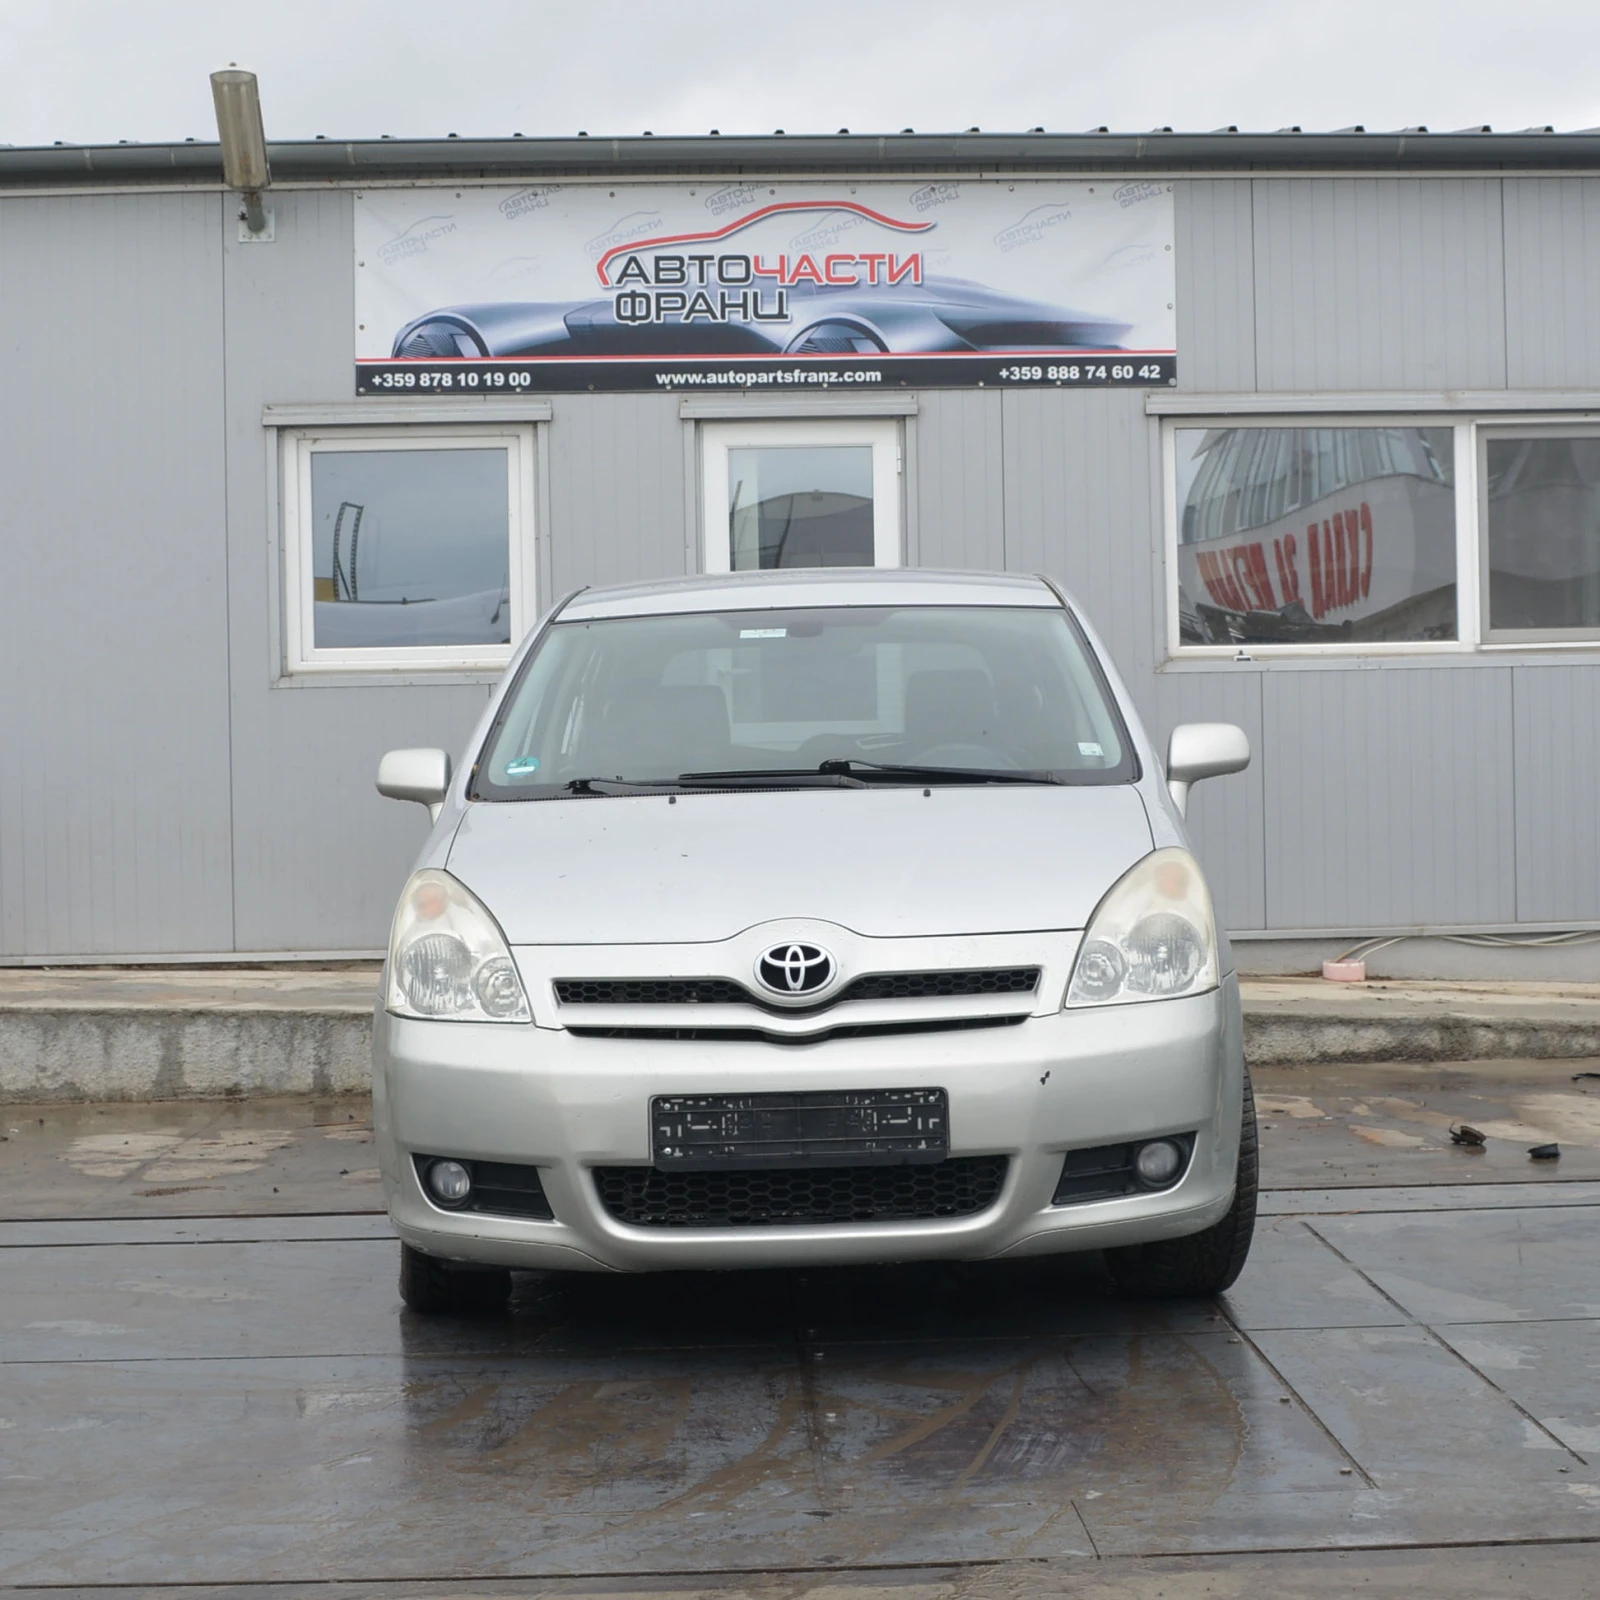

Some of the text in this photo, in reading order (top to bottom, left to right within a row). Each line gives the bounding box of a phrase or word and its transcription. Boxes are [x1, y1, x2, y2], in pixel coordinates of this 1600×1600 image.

[614, 252, 921, 285] АВТОЧАСТИ
[615, 289, 790, 323] ФРАНЦ
[372, 372, 531, 387] +359 878 10 19 00
[655, 369, 882, 386] www.autopartsfranz.com
[999, 365, 1161, 380] +359 888 74 60 42
